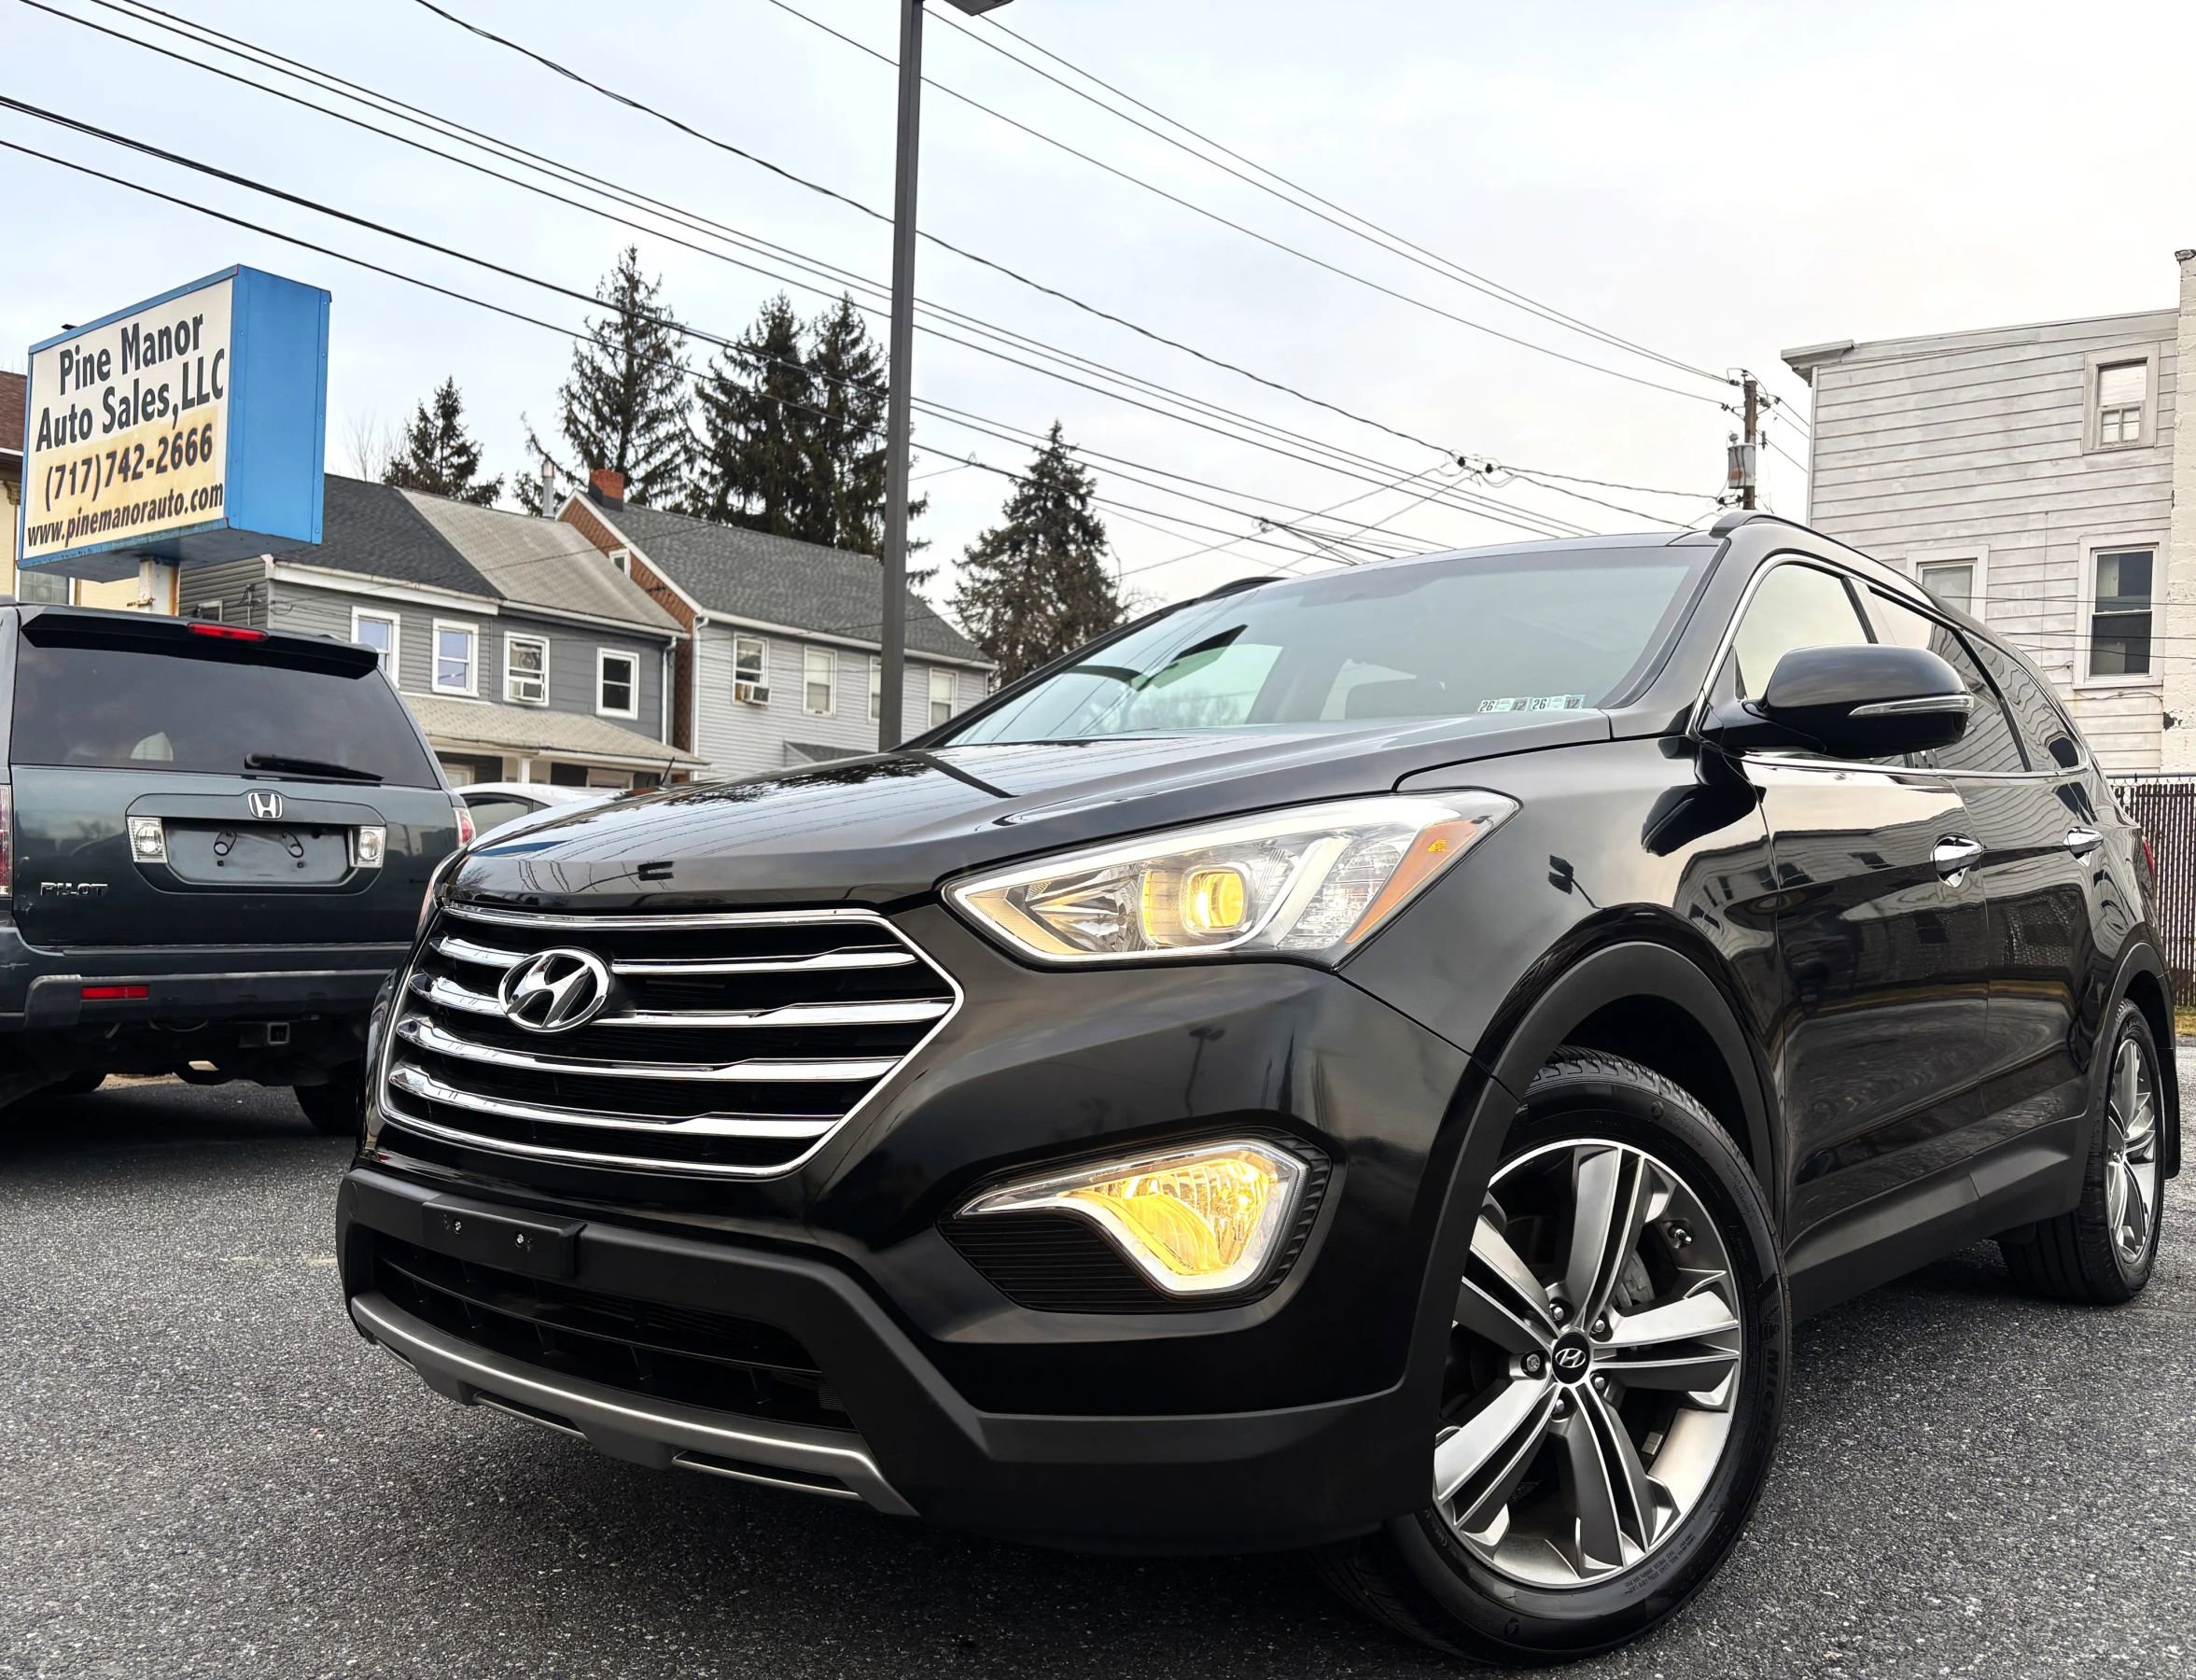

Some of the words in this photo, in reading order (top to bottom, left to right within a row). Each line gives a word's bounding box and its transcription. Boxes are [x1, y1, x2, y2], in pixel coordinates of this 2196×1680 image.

[60, 344, 111, 396] Pine
[120, 314, 203, 374] Manor
[35, 403, 93, 453] Auto
[27, 482, 223, 548] www.pinemanorauto.com
[1480, 701, 1494, 711] 26
[1532, 699, 1546, 709] 26
[40, 882, 107, 896] PILOT
